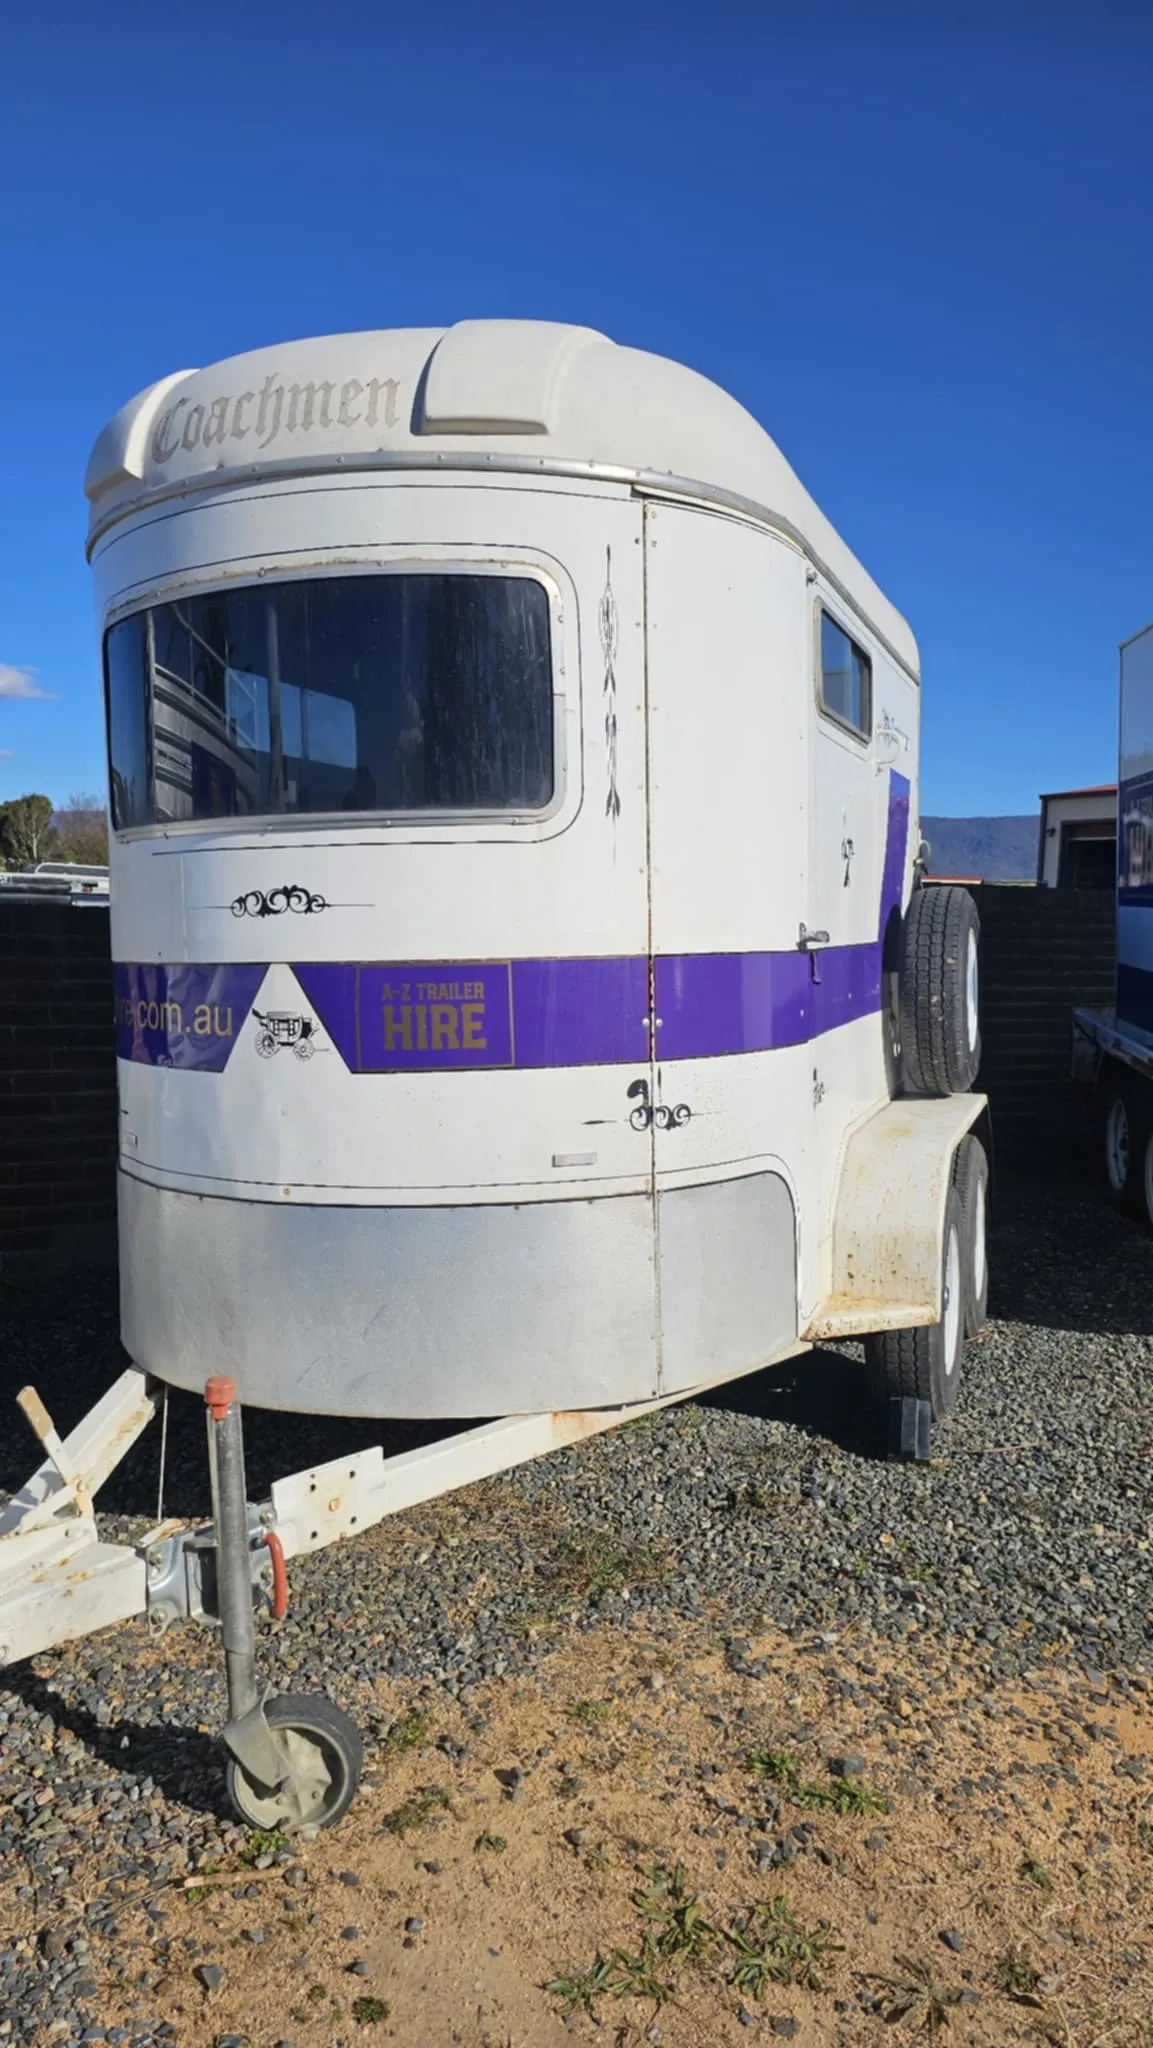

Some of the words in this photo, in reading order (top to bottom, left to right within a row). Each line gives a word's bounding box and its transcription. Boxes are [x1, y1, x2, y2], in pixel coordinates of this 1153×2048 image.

[152, 373, 400, 464] Coachmen
[382, 983, 411, 1001] A-Z
[416, 981, 485, 1000] TRAILER
[383, 1003, 487, 1050] HIRE
